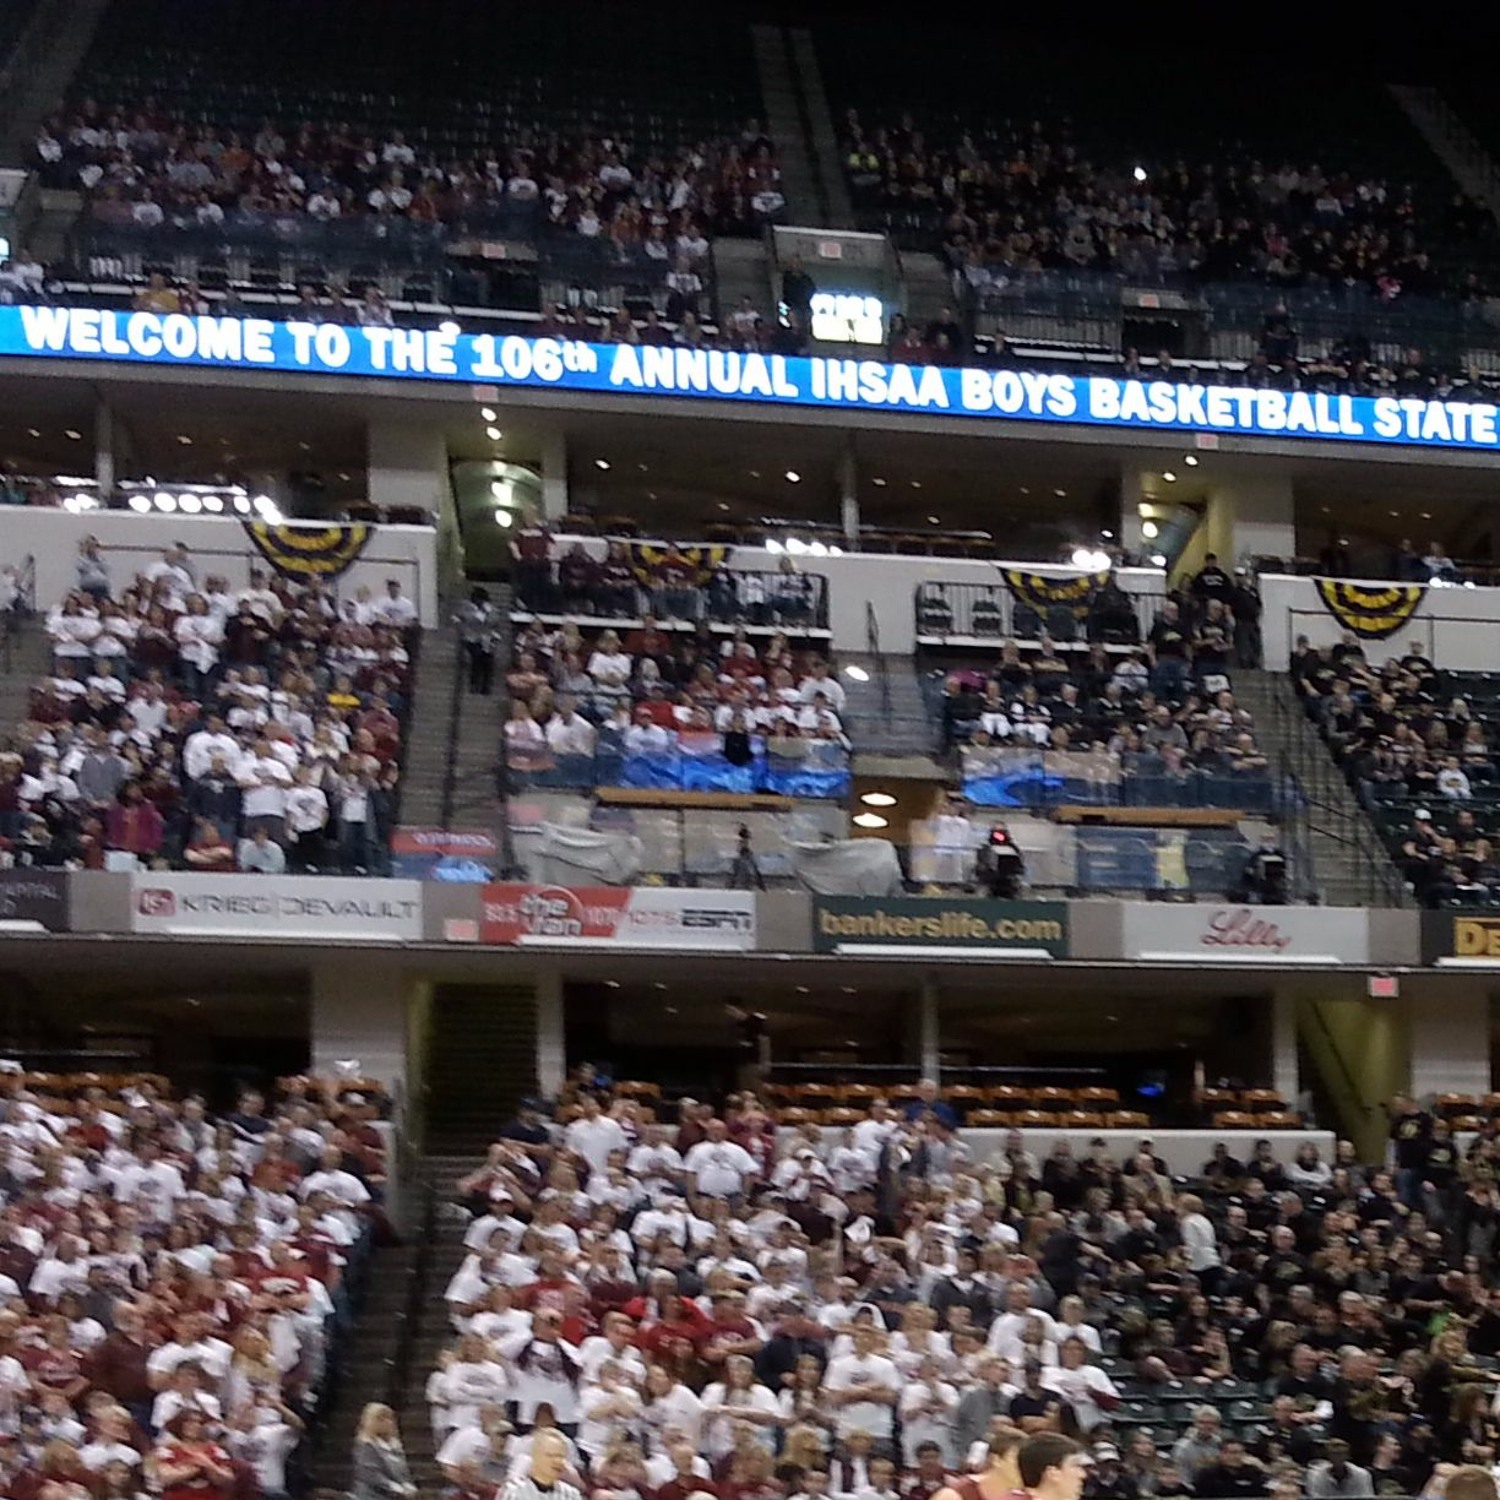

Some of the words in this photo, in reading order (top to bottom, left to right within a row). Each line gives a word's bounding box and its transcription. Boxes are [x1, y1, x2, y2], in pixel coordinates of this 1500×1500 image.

[20, 305, 275, 363] WELCOME
[286, 321, 350, 367] TO
[362, 326, 457, 373] THE
[471, 334, 597, 380] 106th
[610, 344, 798, 398] ANNUAL
[811, 357, 949, 408] IHSAA
[961, 368, 1076, 417] BOYS
[1090, 377, 1363, 435] BASKETBALL
[1373, 397, 1498, 443] STATE
[280, 898, 418, 919] DEVAULT
[819, 908, 1062, 940] bankerslife.com
[1201, 908, 1293, 954] Lilly
